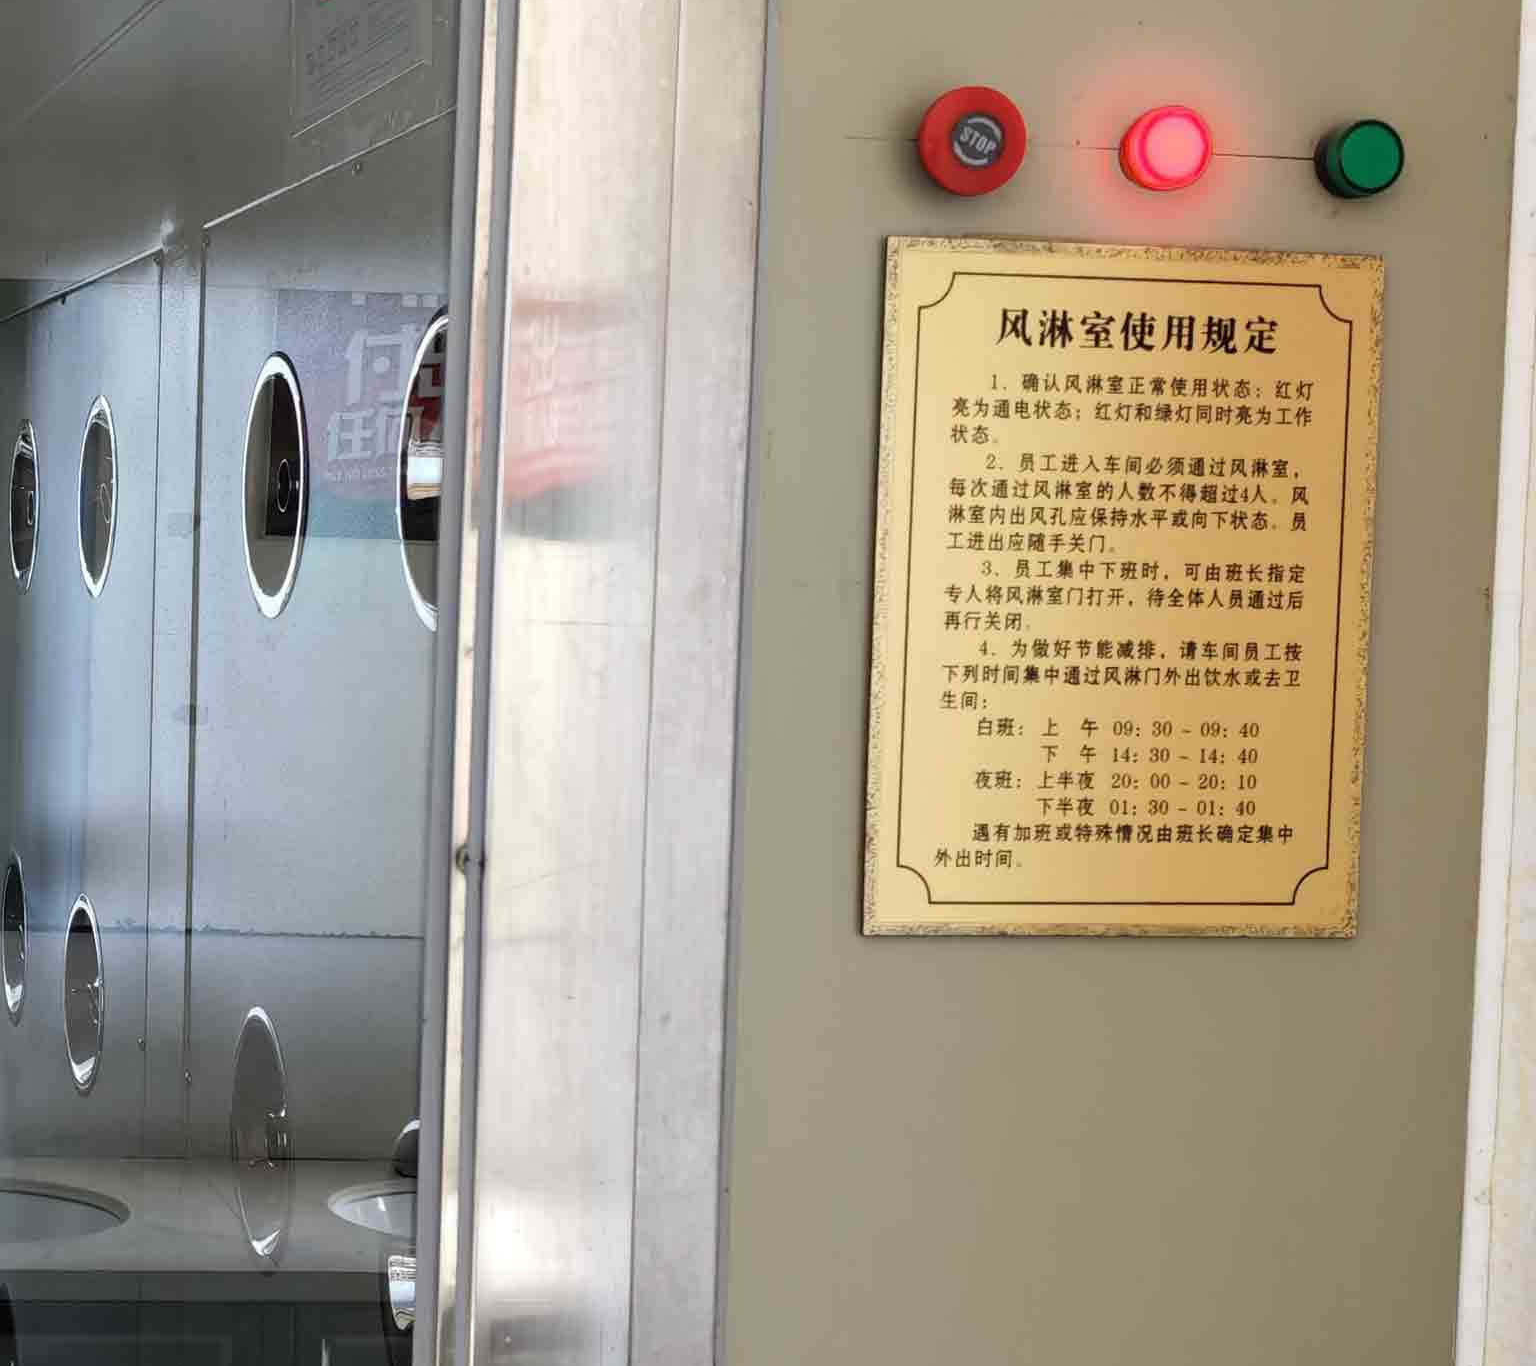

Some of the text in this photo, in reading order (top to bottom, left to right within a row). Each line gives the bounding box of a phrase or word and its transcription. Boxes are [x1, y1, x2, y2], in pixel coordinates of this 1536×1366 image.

[960, 126, 997, 154] STOP
[995, 308, 1279, 355] 风淋室使用规定
